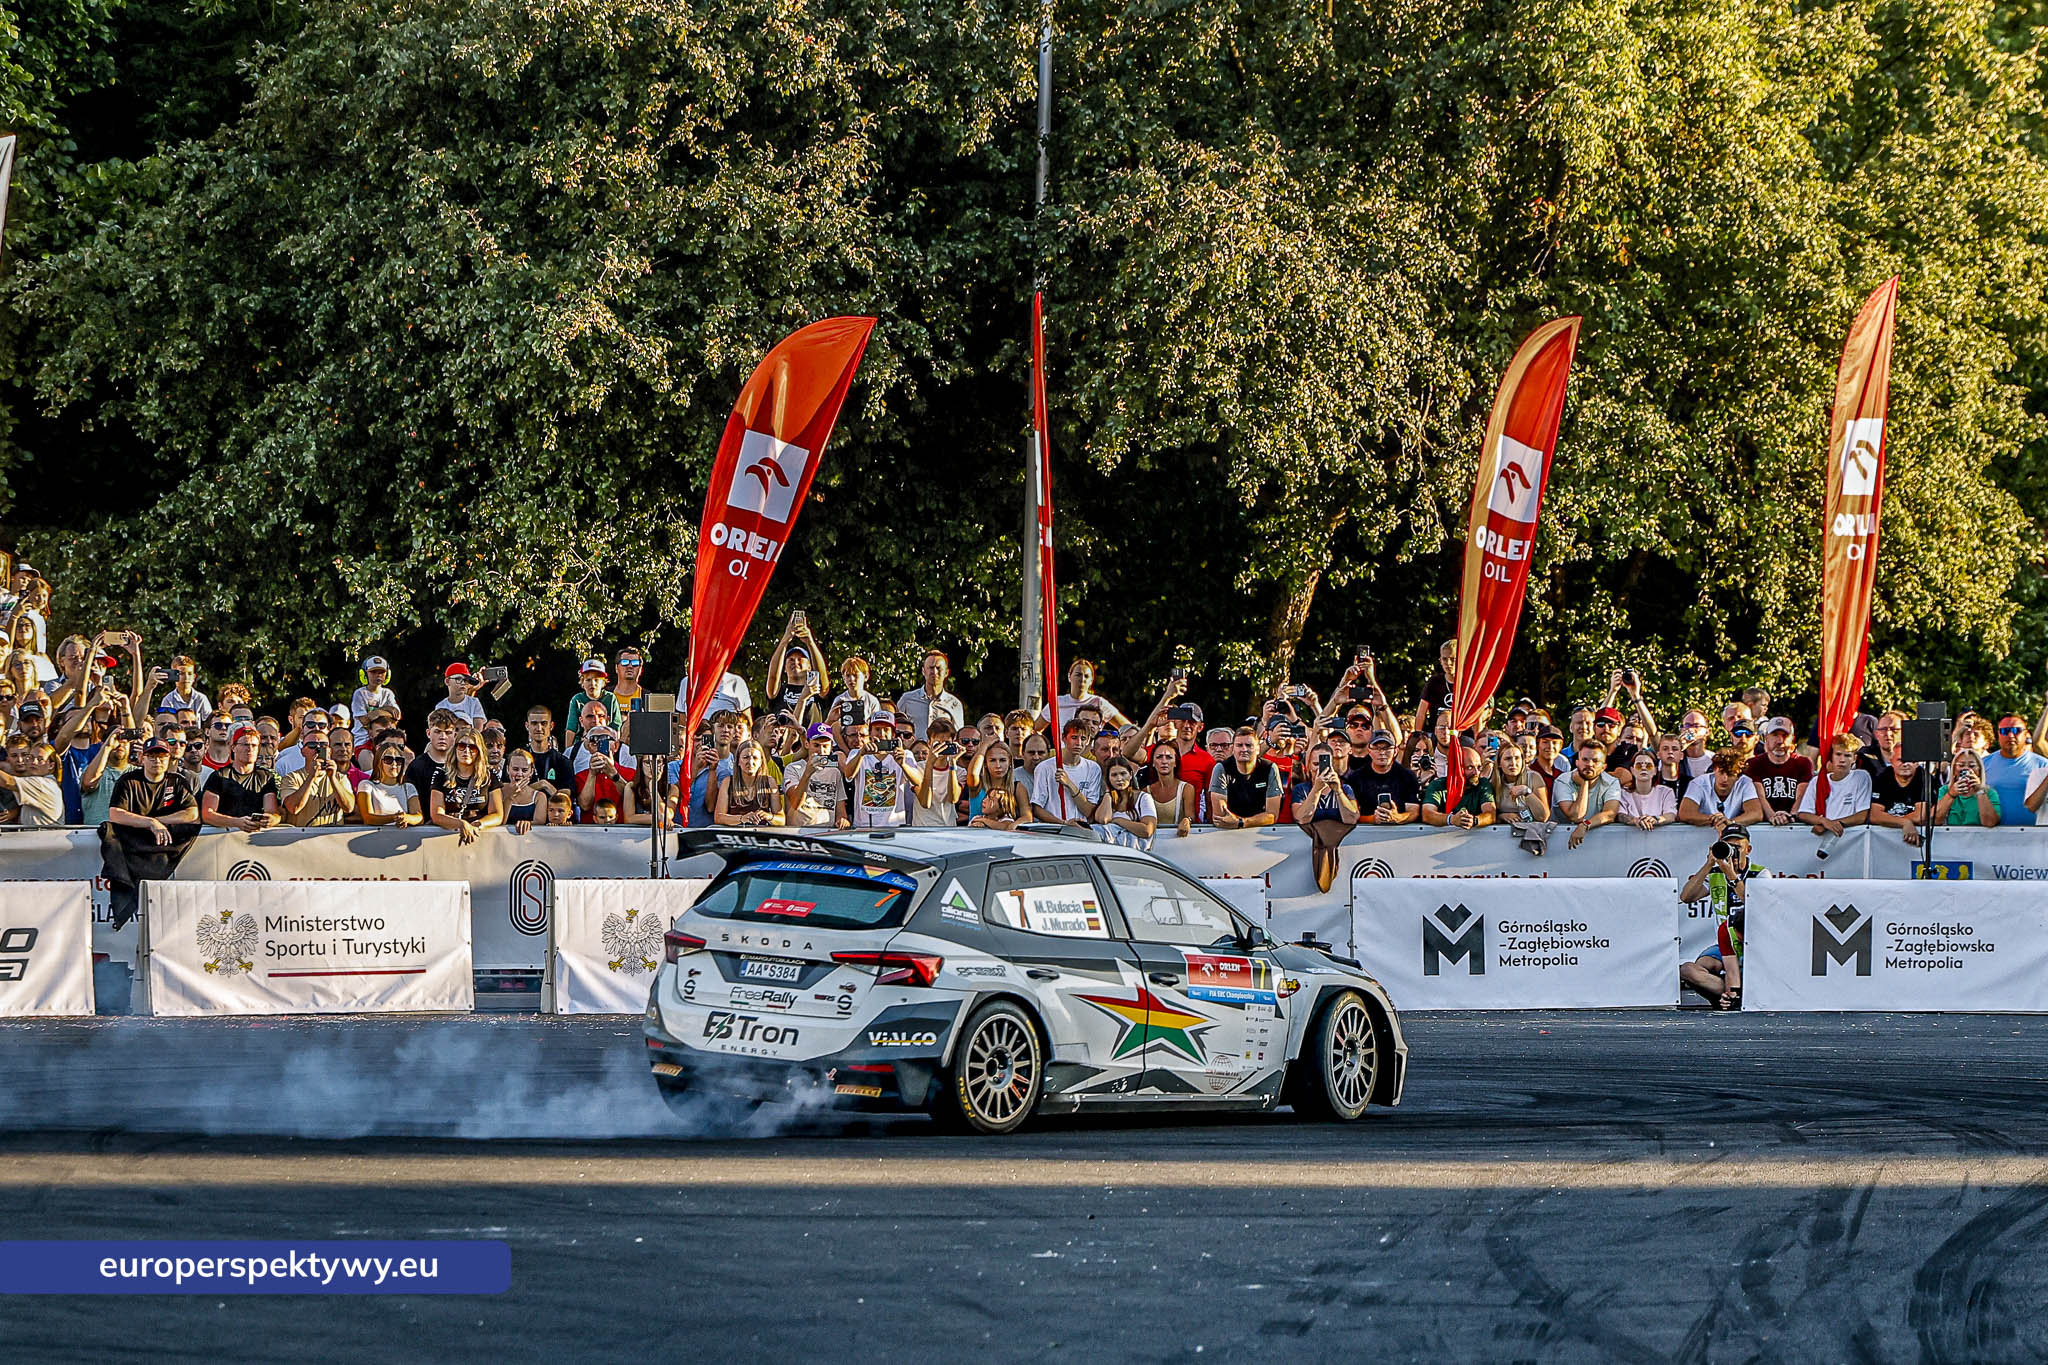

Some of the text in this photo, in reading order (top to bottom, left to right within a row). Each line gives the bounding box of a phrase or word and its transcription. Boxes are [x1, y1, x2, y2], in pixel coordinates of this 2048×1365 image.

[1484, 561, 1512, 583] OIL
[715, 833, 831, 855] BULACIA
[777, 862, 809, 870] FOLLOW
[874, 888, 902, 908] 7
[1009, 889, 1031, 929] 7
[1034, 900, 1082, 914] M. Bulacia
[265, 915, 385, 932] Ministerstwo
[1041, 917, 1086, 931] J. Murado
[1498, 919, 1587, 935] Górnośląsko
[1886, 923, 1973, 938] Górnośląsko
[265, 936, 425, 960] Sportu i Turystyki
[1219, 962, 1241, 972] ORLEN
[1499, 954, 1578, 969] Metropolia
[1885, 957, 1963, 972] Metropolia
[1255, 959, 1266, 989] 7
[721, 1044, 778, 1056] ENERGY
